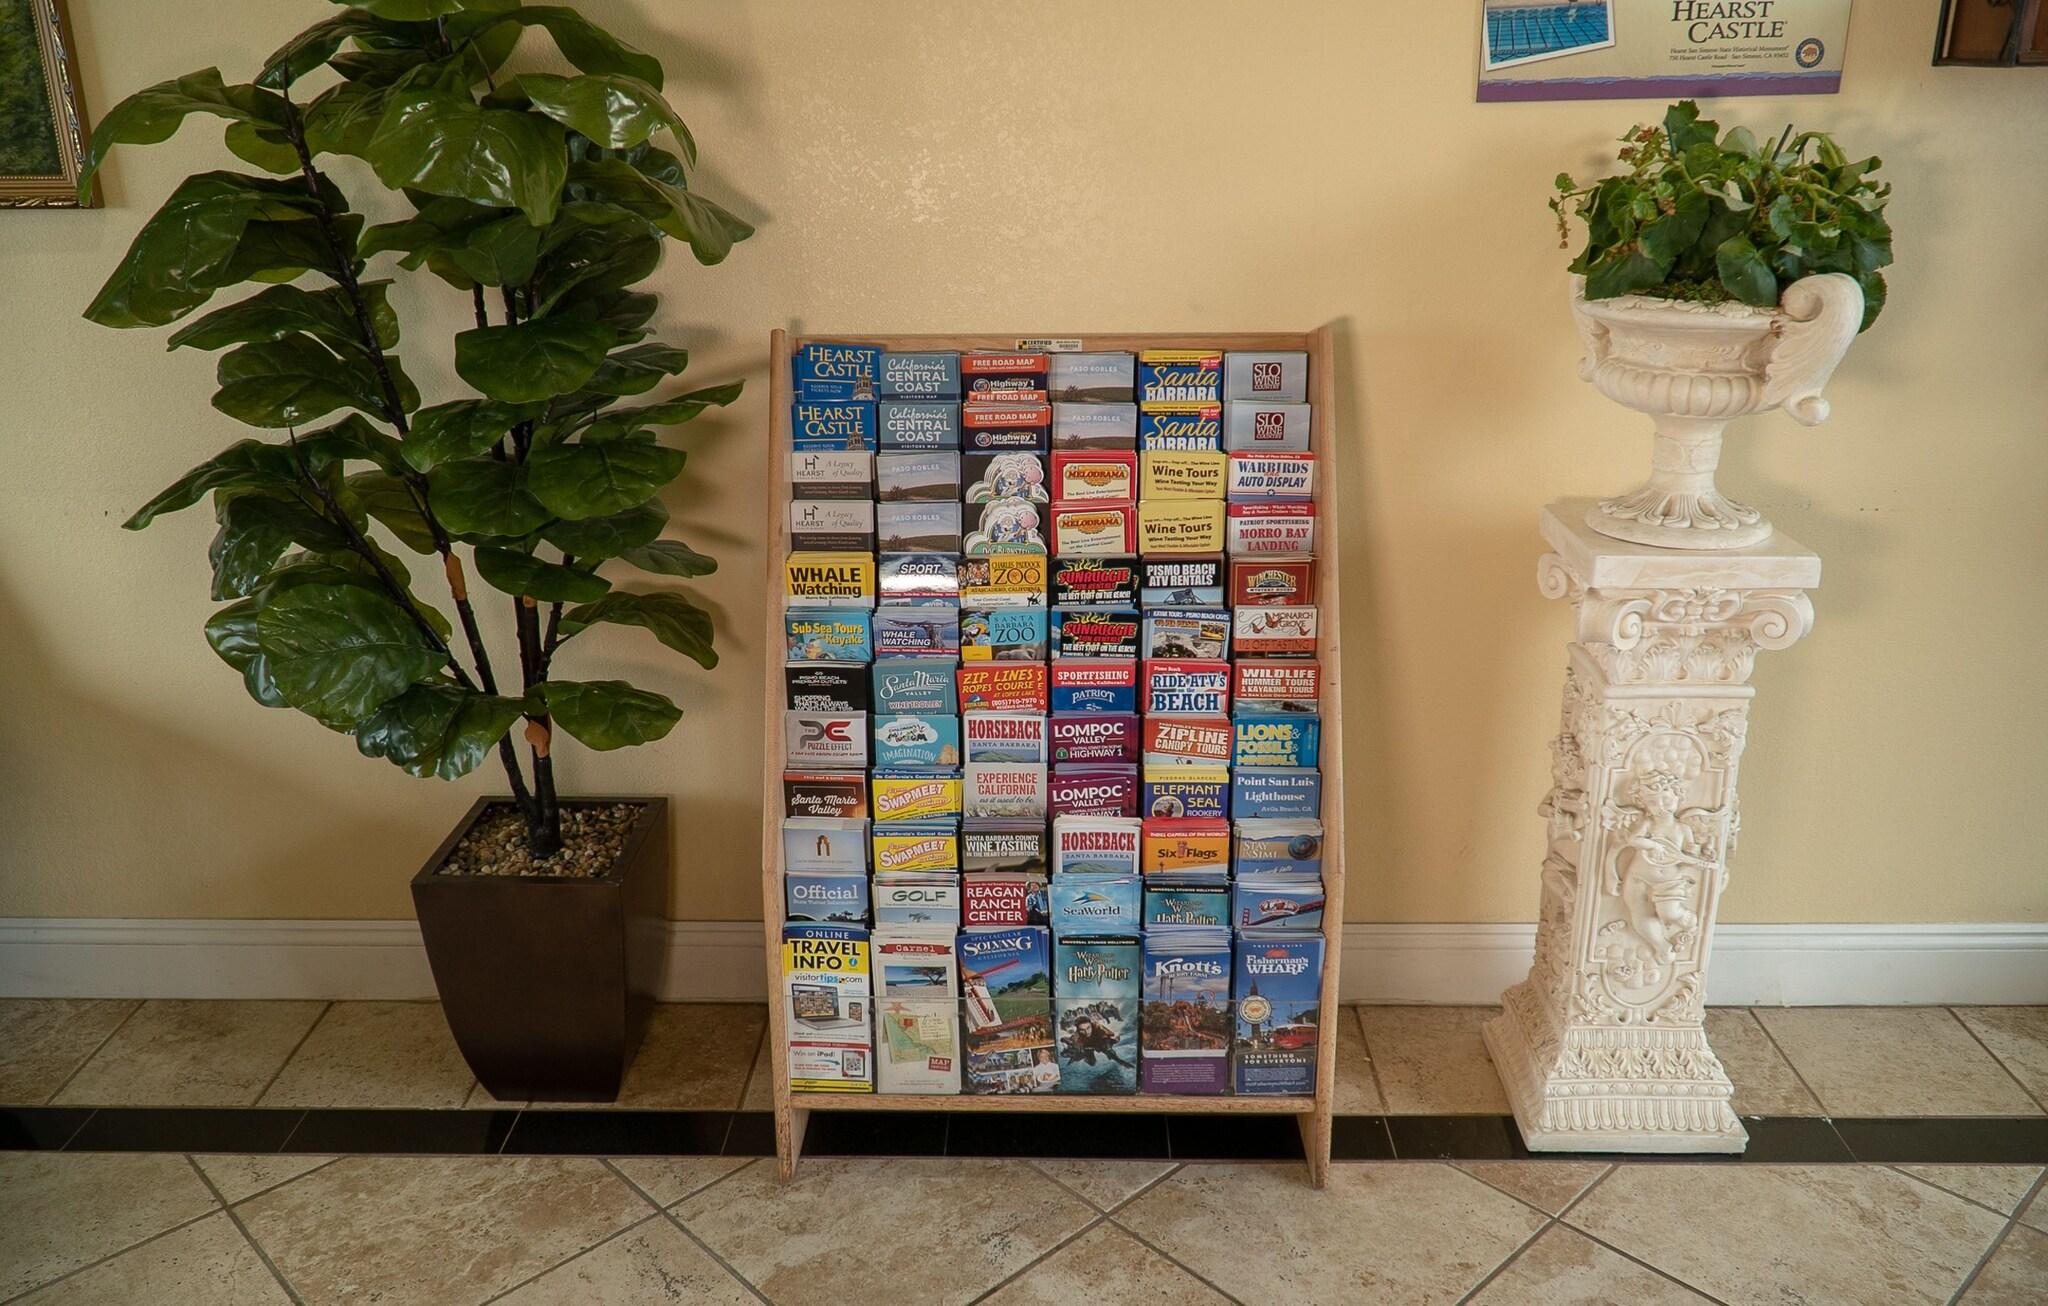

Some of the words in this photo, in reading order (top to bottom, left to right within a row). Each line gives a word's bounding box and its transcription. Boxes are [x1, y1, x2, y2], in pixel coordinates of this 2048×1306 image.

[1671, 0, 1774, 21] HEARST
[1688, 21, 1785, 43] CASTLE
[809, 347, 875, 363] HEARST
[815, 362, 873, 378] CASTLE
[888, 358, 945, 375] California's
[1254, 364, 1281, 376] SLO
[886, 372, 949, 381] CENTRAL
[1144, 366, 1220, 390] Santa
[1254, 376, 1281, 384] WINE
[895, 382, 940, 392] COAST
[799, 406, 864, 421] HEARST
[889, 407, 948, 424] California's
[1256, 413, 1284, 426] SLO
[805, 420, 864, 436] CASTLE
[887, 421, 951, 430] CENTRAL
[1144, 416, 1220, 441] Santa
[1256, 425, 1283, 434] WINE
[896, 431, 942, 441] COAST
[1153, 465, 1183, 477] Wine
[1186, 467, 1219, 478] Tours
[1238, 460, 1309, 473] WARBIRDS
[1067, 470, 1125, 478] MELODRAMA
[1237, 476, 1264, 487] AUTO
[1266, 476, 1307, 487] DISPLAY
[1061, 517, 1119, 528] MELODRAMA
[1145, 524, 1176, 535] Wine
[1179, 522, 1212, 533] Tours
[1239, 528, 1280, 539] MORRO
[1286, 528, 1309, 538] BAY
[1247, 541, 1299, 551] LANDING
[790, 567, 861, 582] WHALE
[900, 564, 941, 574] SPORT
[1147, 564, 1180, 576] PISMO
[1182, 563, 1216, 575] BEACH
[994, 568, 1041, 584] ZOO
[1058, 569, 1129, 583] SUNBUGGIE
[1149, 576, 1170, 587] ATV
[1171, 574, 1214, 587] RENTALS
[1247, 570, 1297, 587] WINCHESTER
[791, 582, 862, 598] Watching
[994, 614, 1034, 622] SANTA
[1272, 612, 1313, 620] MONARCH
[791, 623, 813, 634] Sub
[813, 623, 832, 634] Sea
[833, 623, 864, 634] Tours
[994, 621, 1034, 629] BARBARA
[1063, 623, 1136, 636] SUNBUGGIE
[995, 628, 1035, 643] ZOO
[882, 638, 931, 646] WATCHING
[963, 671, 990, 685] ZIP
[994, 669, 1033, 682] LINES
[1057, 671, 1129, 680] SPORTFISHING
[1242, 669, 1316, 678] WILDLIFE
[880, 675, 915, 699] Santa
[913, 670, 949, 687] Maria
[962, 683, 992, 693] ROPES
[996, 681, 1034, 691] COURSE
[1153, 675, 1186, 687] RIDE
[1286, 678, 1315, 686] TOURS
[1071, 689, 1115, 703] PATRIOT
[1154, 693, 1219, 710] BEACH
[968, 719, 1041, 739] HORSEBACK
[1054, 723, 1125, 737] LOMPOC
[1237, 724, 1293, 741] LIONS
[1291, 727, 1301, 739] &
[1072, 736, 1106, 744] VALLEY
[1157, 726, 1229, 745] ZIPLINE
[807, 742, 830, 750] PUZZLE
[831, 742, 852, 750] EFFECT
[1155, 738, 1193, 752] CANOPY
[1196, 742, 1228, 755] TOURS
[882, 749, 936, 761] IMAGINATION
[1070, 749, 1116, 759] HIGHWAY
[1117, 748, 1123, 757] 1
[977, 773, 1038, 783] EXPERIENCE
[1237, 777, 1267, 786] Point
[1268, 777, 1290, 786] San
[1291, 777, 1314, 786] Luis
[978, 784, 1036, 795] CALIFORNIA
[1053, 785, 1123, 801] LOMPOC
[1153, 784, 1222, 795] ELEPHANT
[791, 793, 823, 806] Santa
[824, 794, 858, 805] Maria
[878, 784, 945, 812] SWAPMEET
[1072, 799, 1105, 807] VALLEY
[1187, 797, 1221, 808] SEAL
[1245, 791, 1305, 803] Lighthouse
[808, 804, 843, 816] Valley
[966, 841, 993, 851] WINE
[995, 841, 1039, 851] TASTING
[1061, 832, 1136, 851] HORSEBACK
[880, 840, 946, 867] SWAPMEET
[1157, 848, 1177, 858] Six
[1186, 848, 1218, 859] Flags
[793, 884, 858, 899] Official
[892, 890, 947, 902] GOLF
[966, 887, 1024, 897] REAGAN
[970, 899, 1021, 909] RANCH
[968, 911, 1024, 921] CENTER
[1063, 905, 1120, 916] SeaWorld
[805, 930, 849, 939] ONLINE
[790, 940, 860, 956] TRAVEL
[964, 936, 1032, 957] SOLVANG
[793, 955, 842, 970] INFO
[1246, 954, 1309, 965] Fisherman's
[1155, 958, 1222, 977] Knott's
[1246, 963, 1309, 975] WHARF
[1069, 965, 1097, 983] Harry
[1097, 963, 1129, 985] Potter
[930, 1057, 949, 1065] MAP
